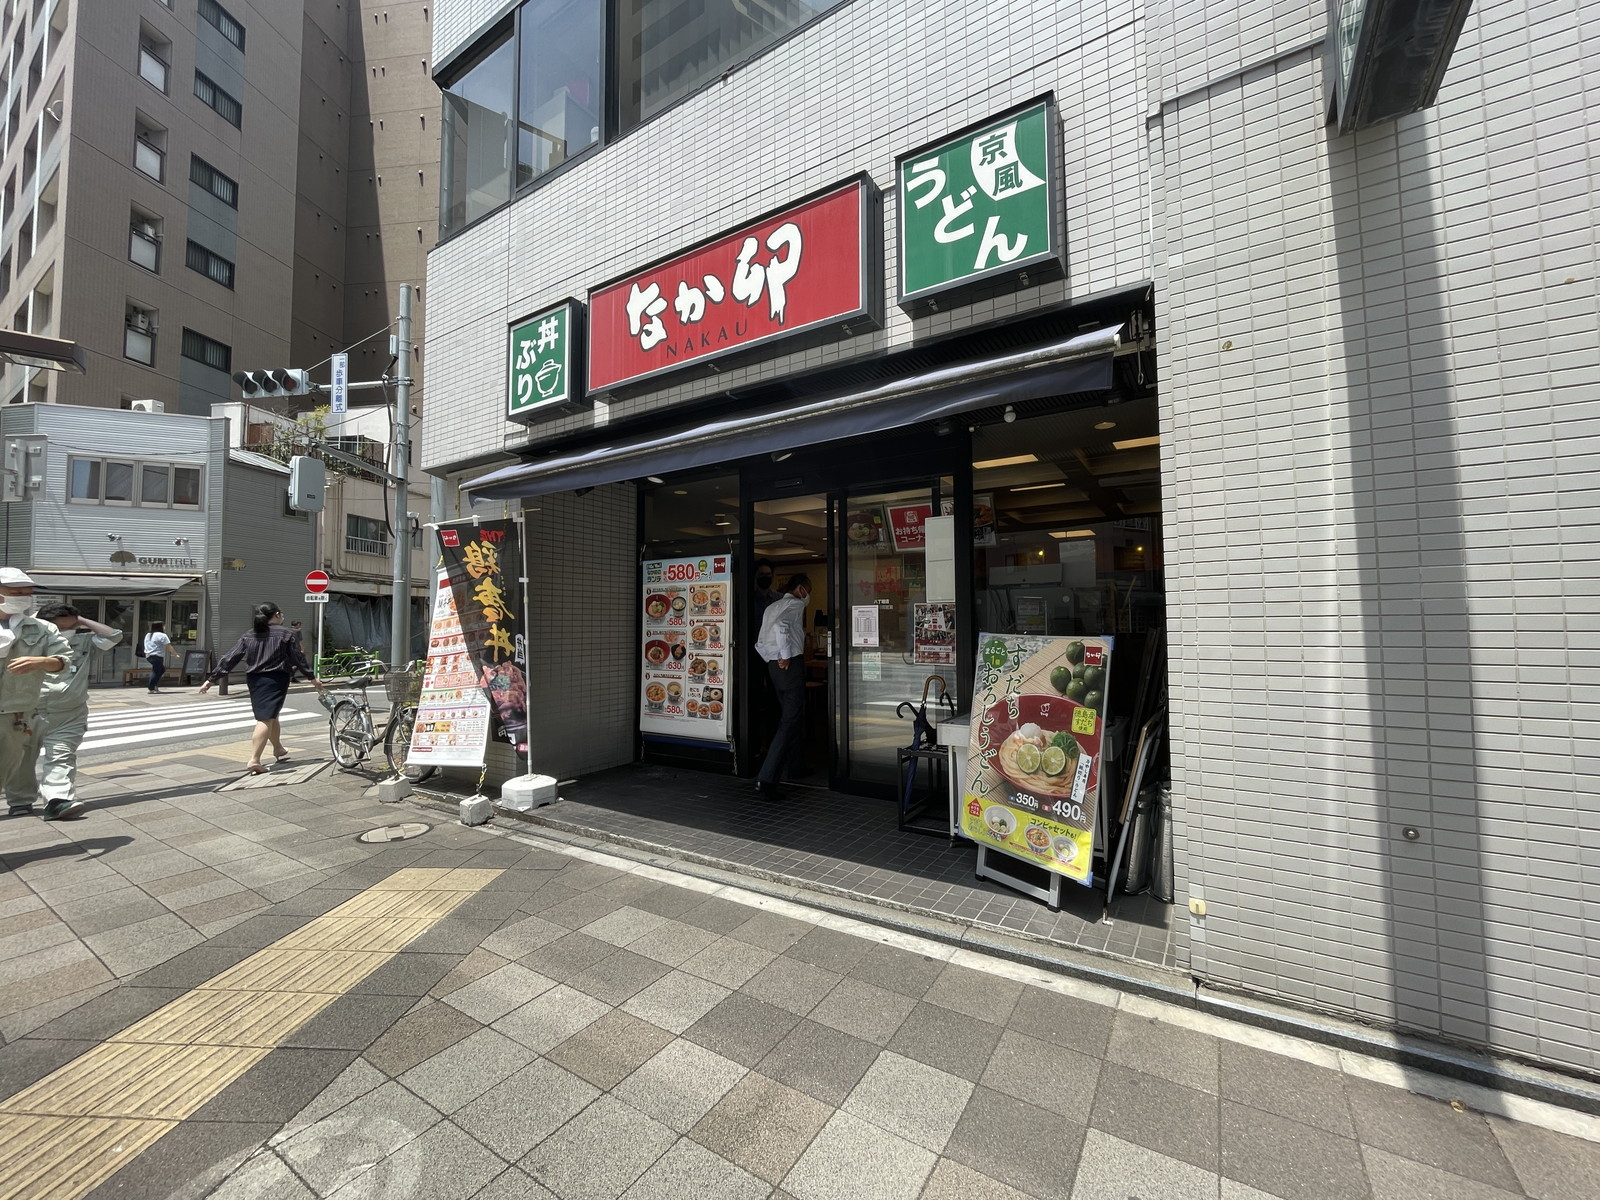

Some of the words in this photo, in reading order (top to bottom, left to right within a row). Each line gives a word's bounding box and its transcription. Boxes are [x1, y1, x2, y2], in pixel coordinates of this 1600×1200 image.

[978, 131, 1024, 197] 京風
[906, 157, 1028, 270] うどん
[626, 221, 803, 353] なか卯
[666, 319, 749, 359] NAKAU
[900, 534, 926, 543] コーナ
[985, 646, 1005, 656] まるごと
[1007, 643, 1028, 719] すだち
[971, 662, 1002, 794] おろしうどん
[1074, 718, 1093, 728] すだち
